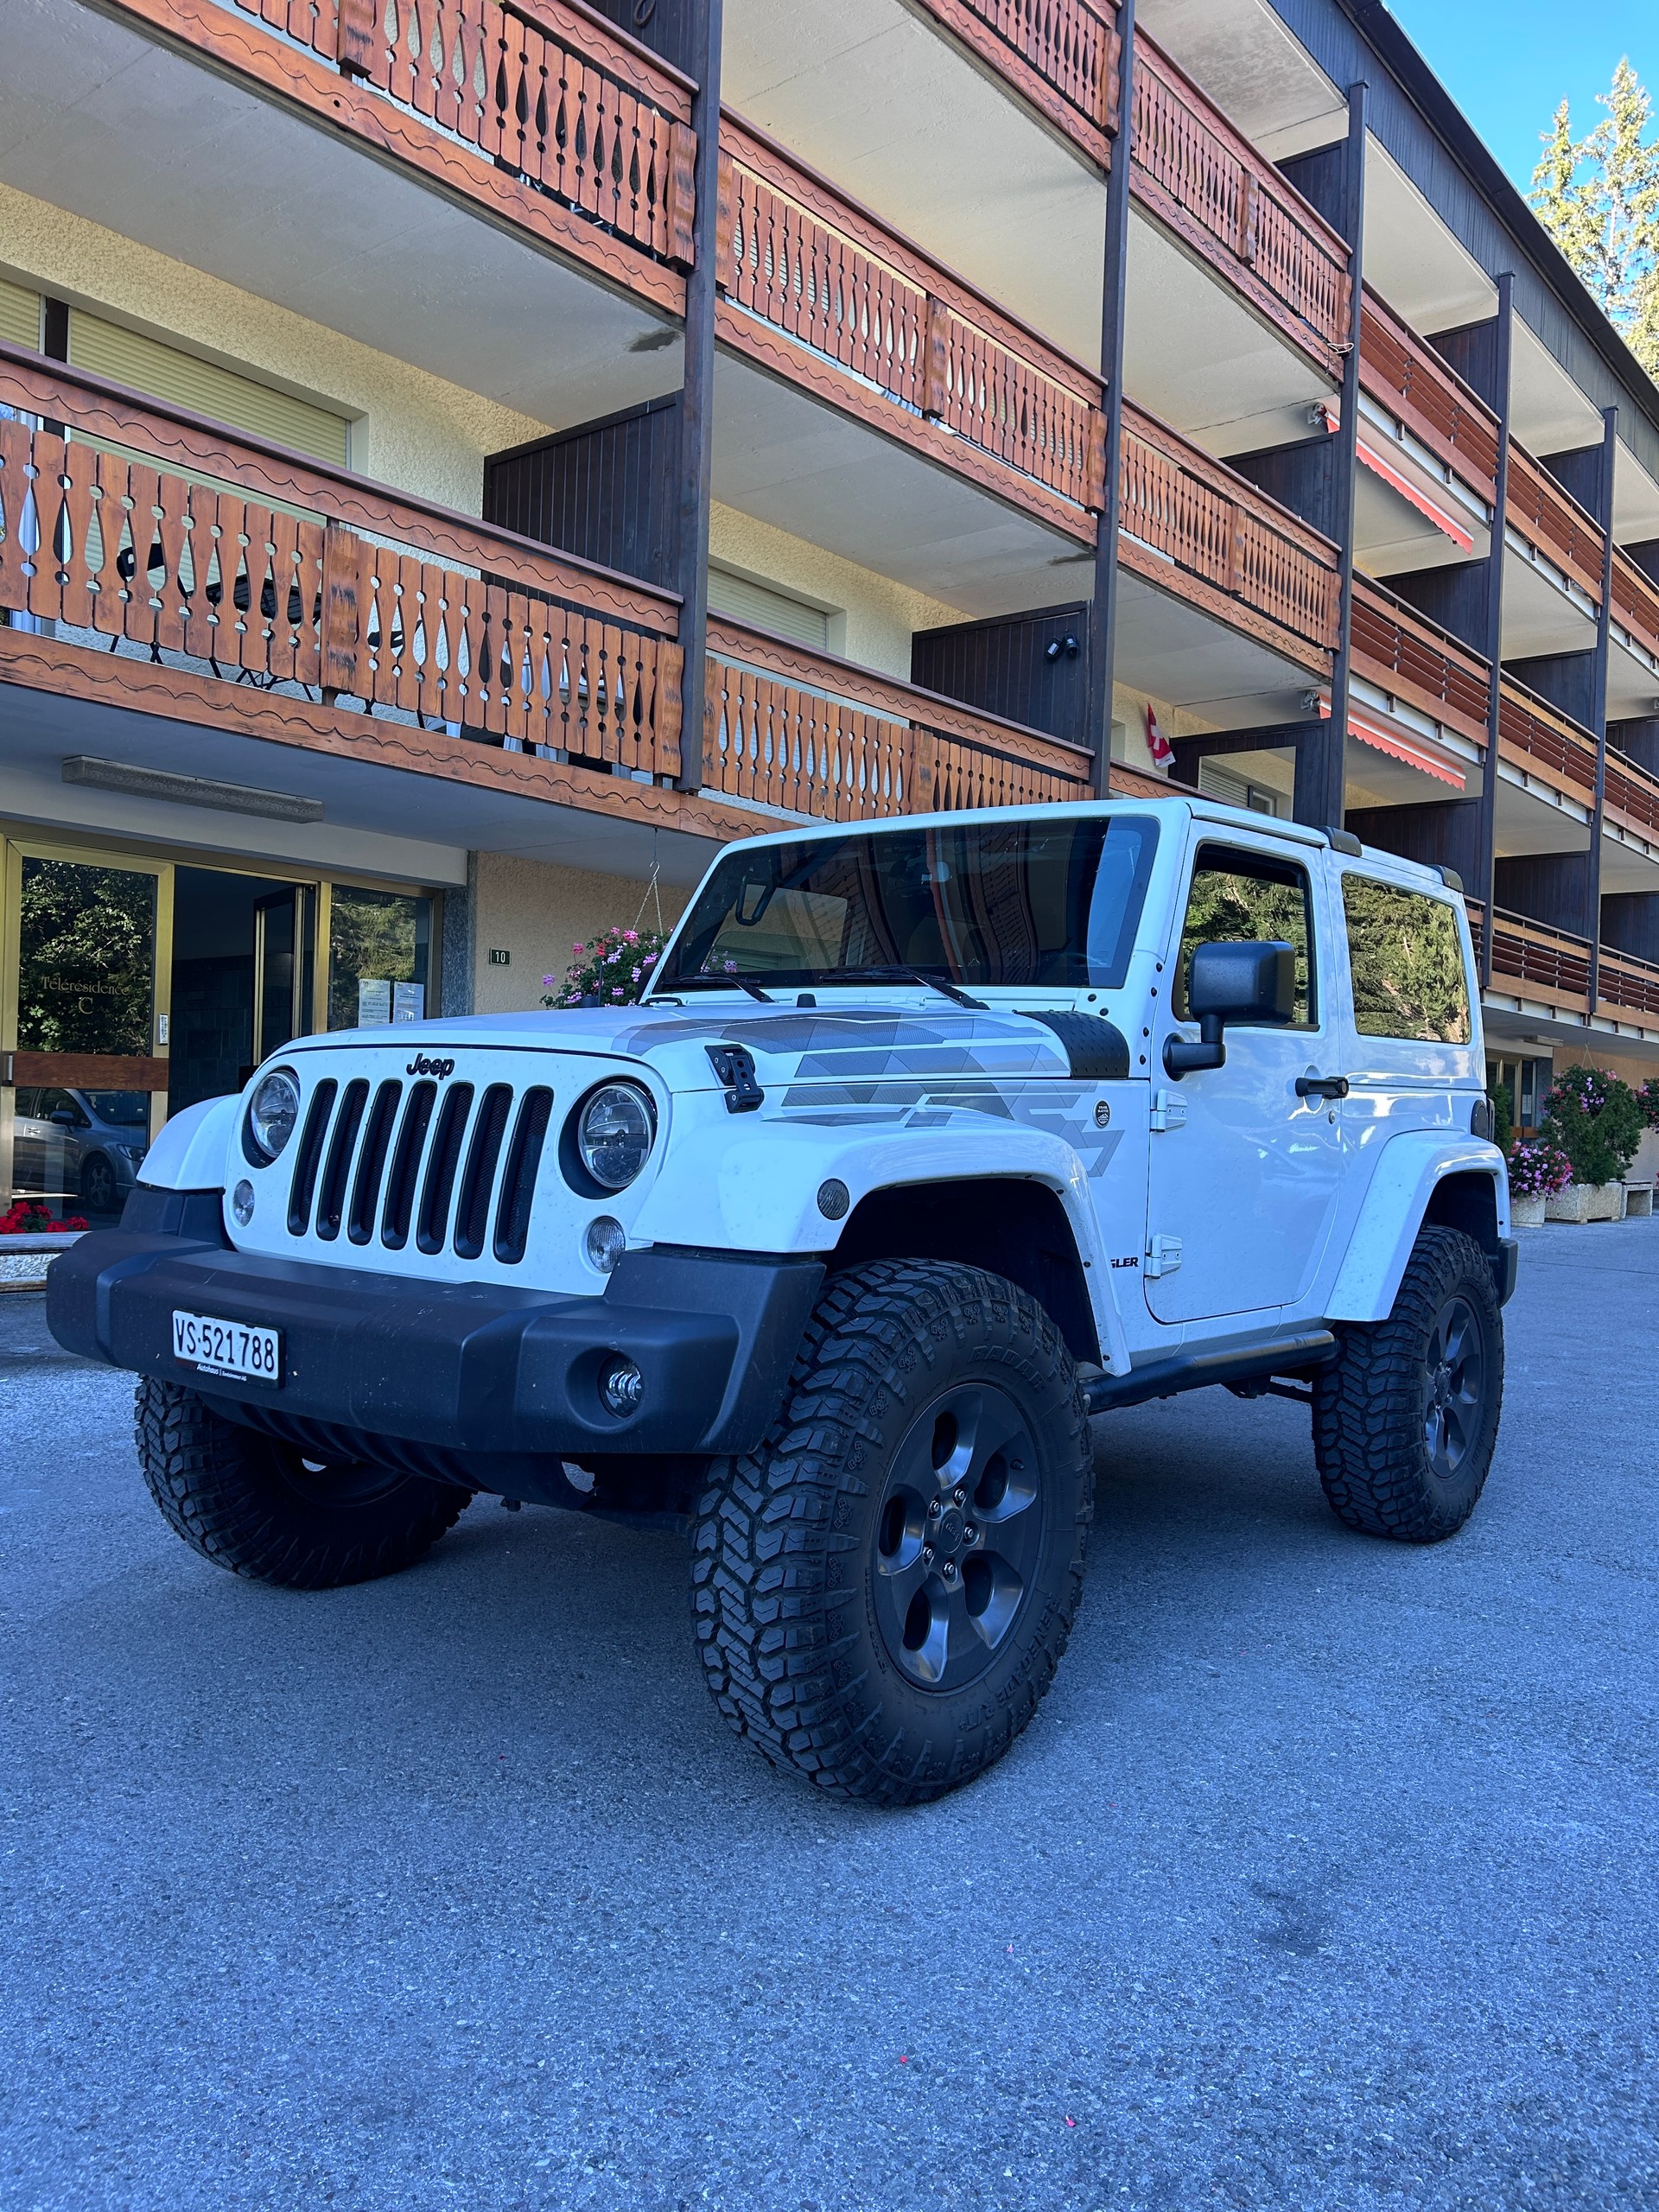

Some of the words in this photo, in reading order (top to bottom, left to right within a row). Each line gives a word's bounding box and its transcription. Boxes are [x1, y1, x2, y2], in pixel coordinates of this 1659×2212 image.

[495, 951, 505, 963] 10
[79, 996, 93, 1014] C
[406, 1052, 455, 1080] Jeep
[197, 1363, 219, 1376] Autohaus
[967, 1344, 1047, 1392] RADAR
[995, 1591, 1061, 1708] RENEGADE
